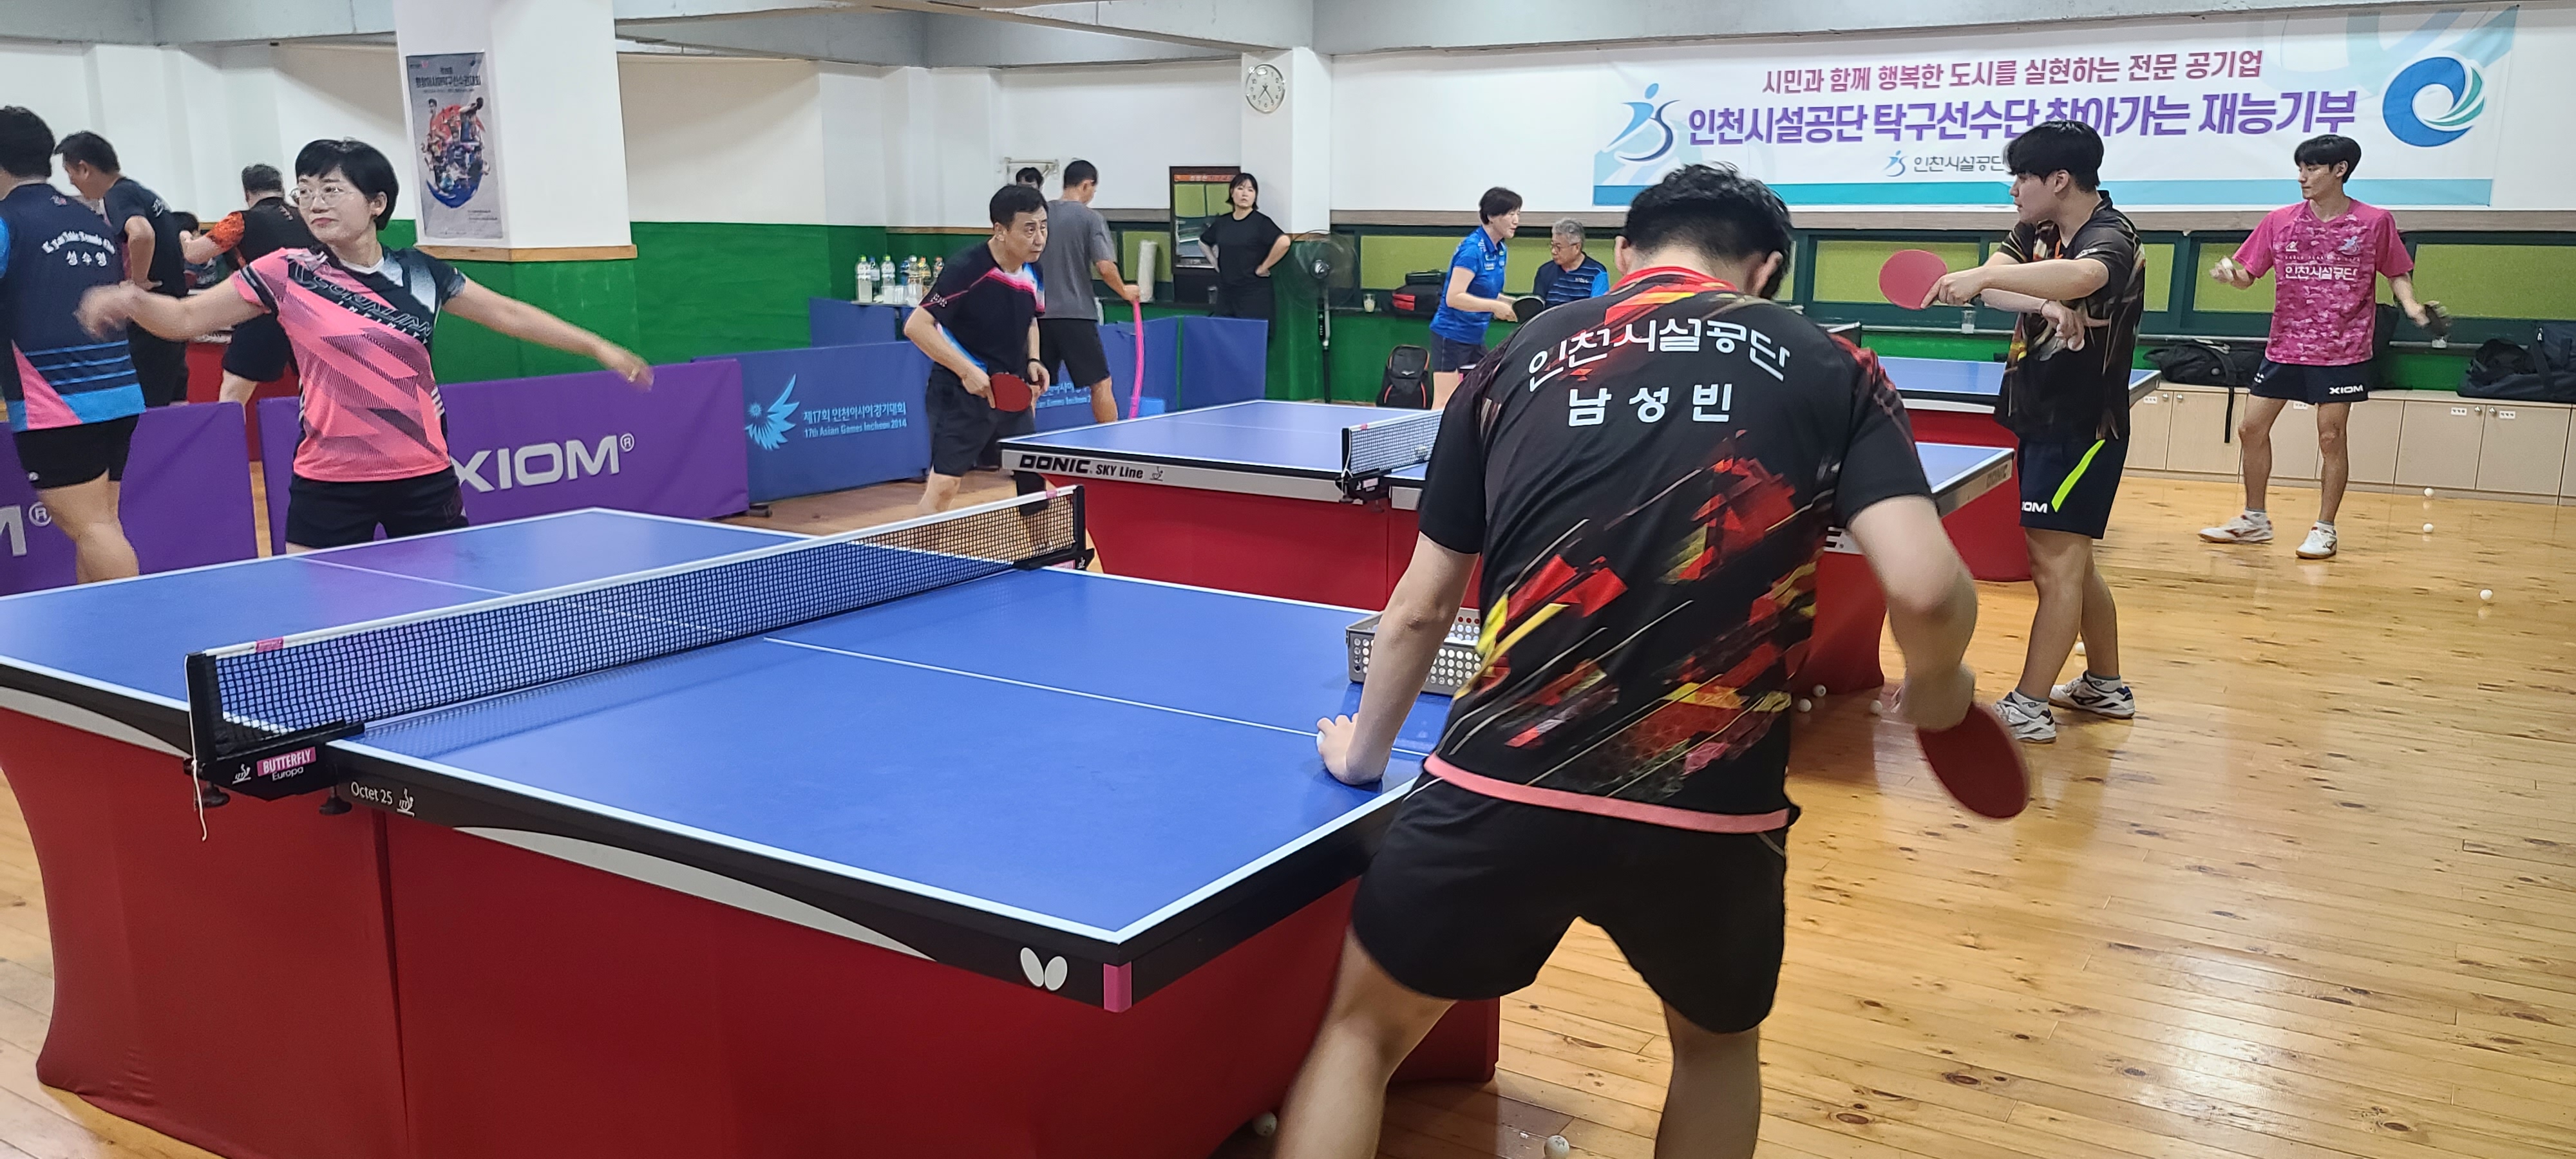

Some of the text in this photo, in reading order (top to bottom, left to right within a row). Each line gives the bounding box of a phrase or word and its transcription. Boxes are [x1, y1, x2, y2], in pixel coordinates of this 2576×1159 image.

[1762, 50, 2263, 95] 시민과 함께 행복한 도시를 실현하는 전문 공기업
[1689, 104, 1868, 146] 인천시설공단
[1873, 98, 2041, 143] 탁구선수단
[2197, 90, 2358, 135] 재능기부
[1528, 318, 1791, 393] 인천시설공단
[2329, 384, 2363, 395] XIOM
[1019, 455, 1144, 479] DONIC SKY Line
[263, 749, 312, 773] BUTTERFLY
[272, 766, 304, 782] Europa
[351, 781, 393, 805] Octet 25
